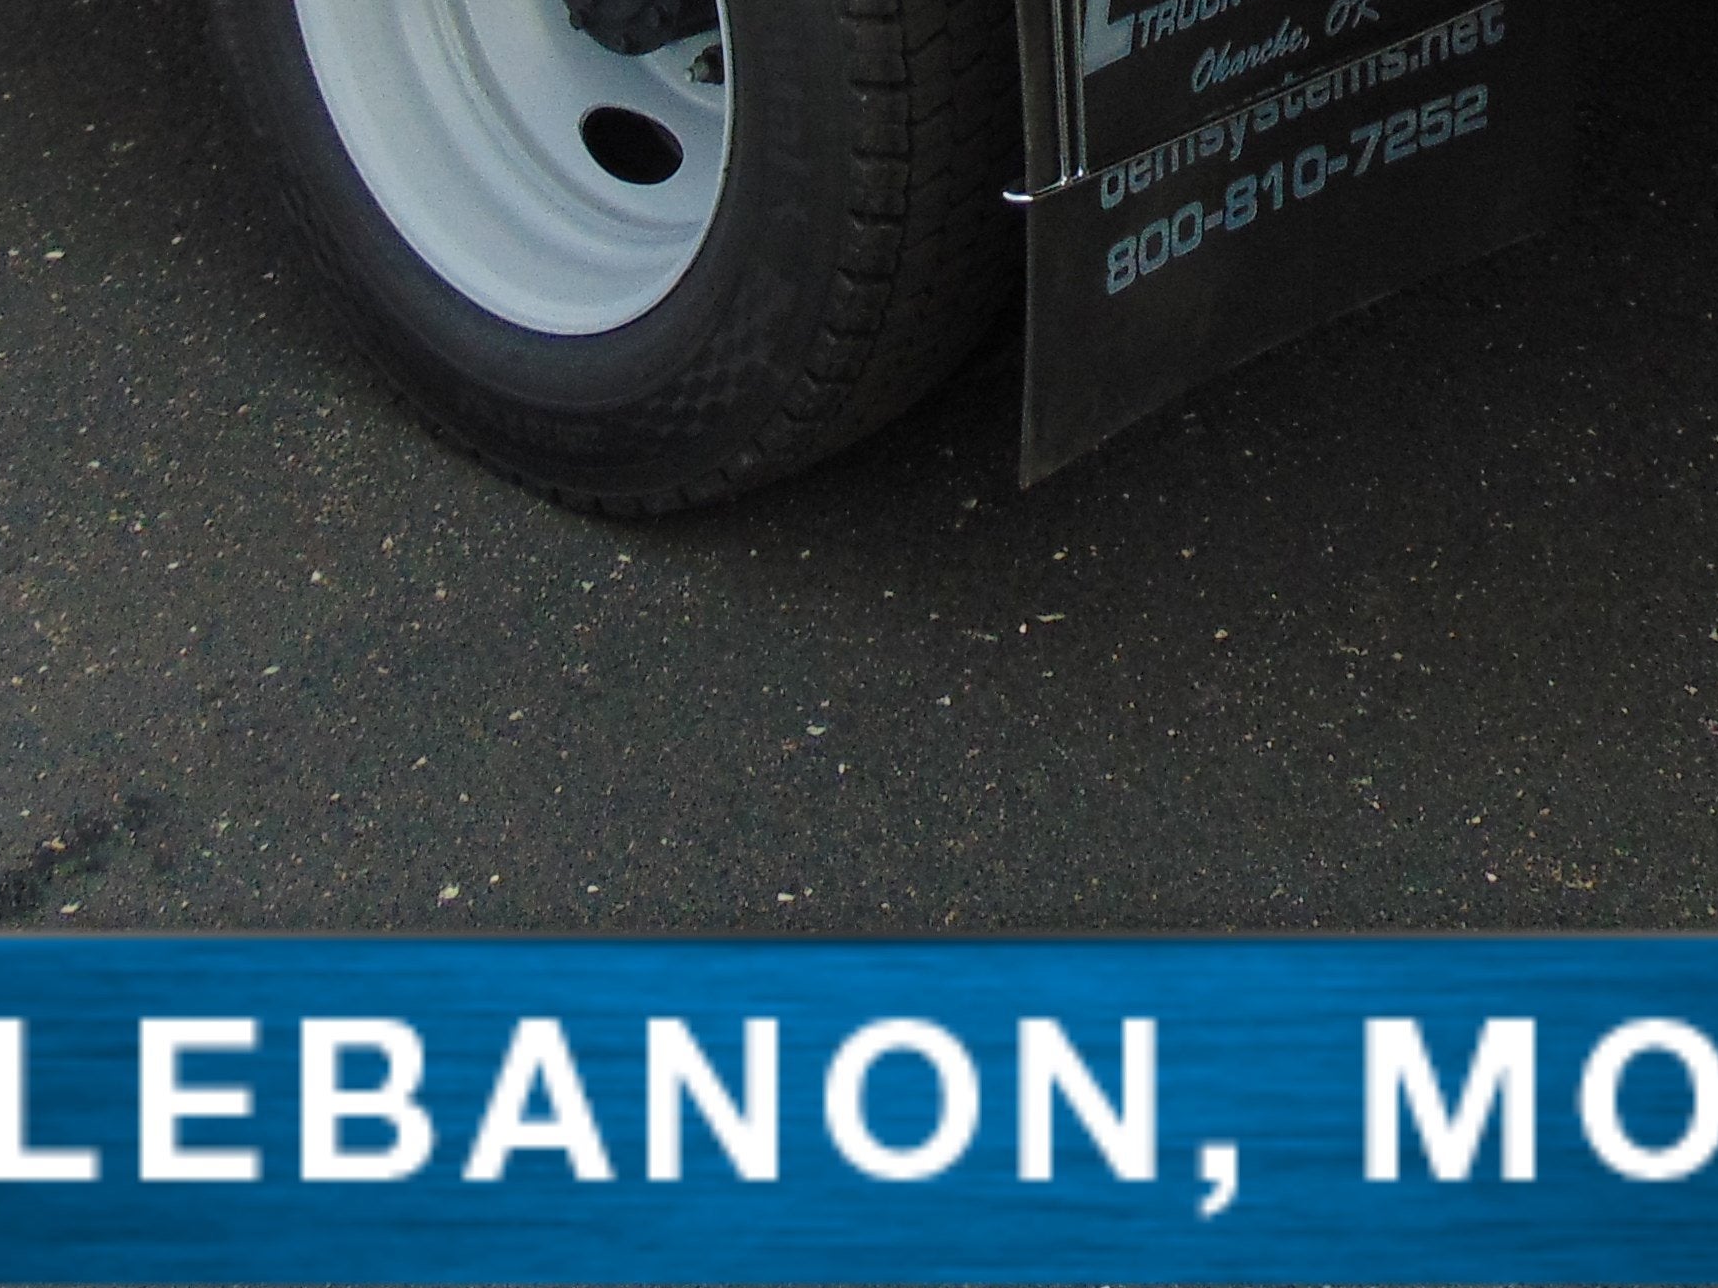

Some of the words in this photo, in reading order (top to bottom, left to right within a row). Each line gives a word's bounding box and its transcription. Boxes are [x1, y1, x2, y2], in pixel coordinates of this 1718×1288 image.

[1099, 2, 1507, 211] oemsystems.net
[1191, 15, 1311, 94] Okarche,
[1105, 83, 1490, 296] 800-810-7252
